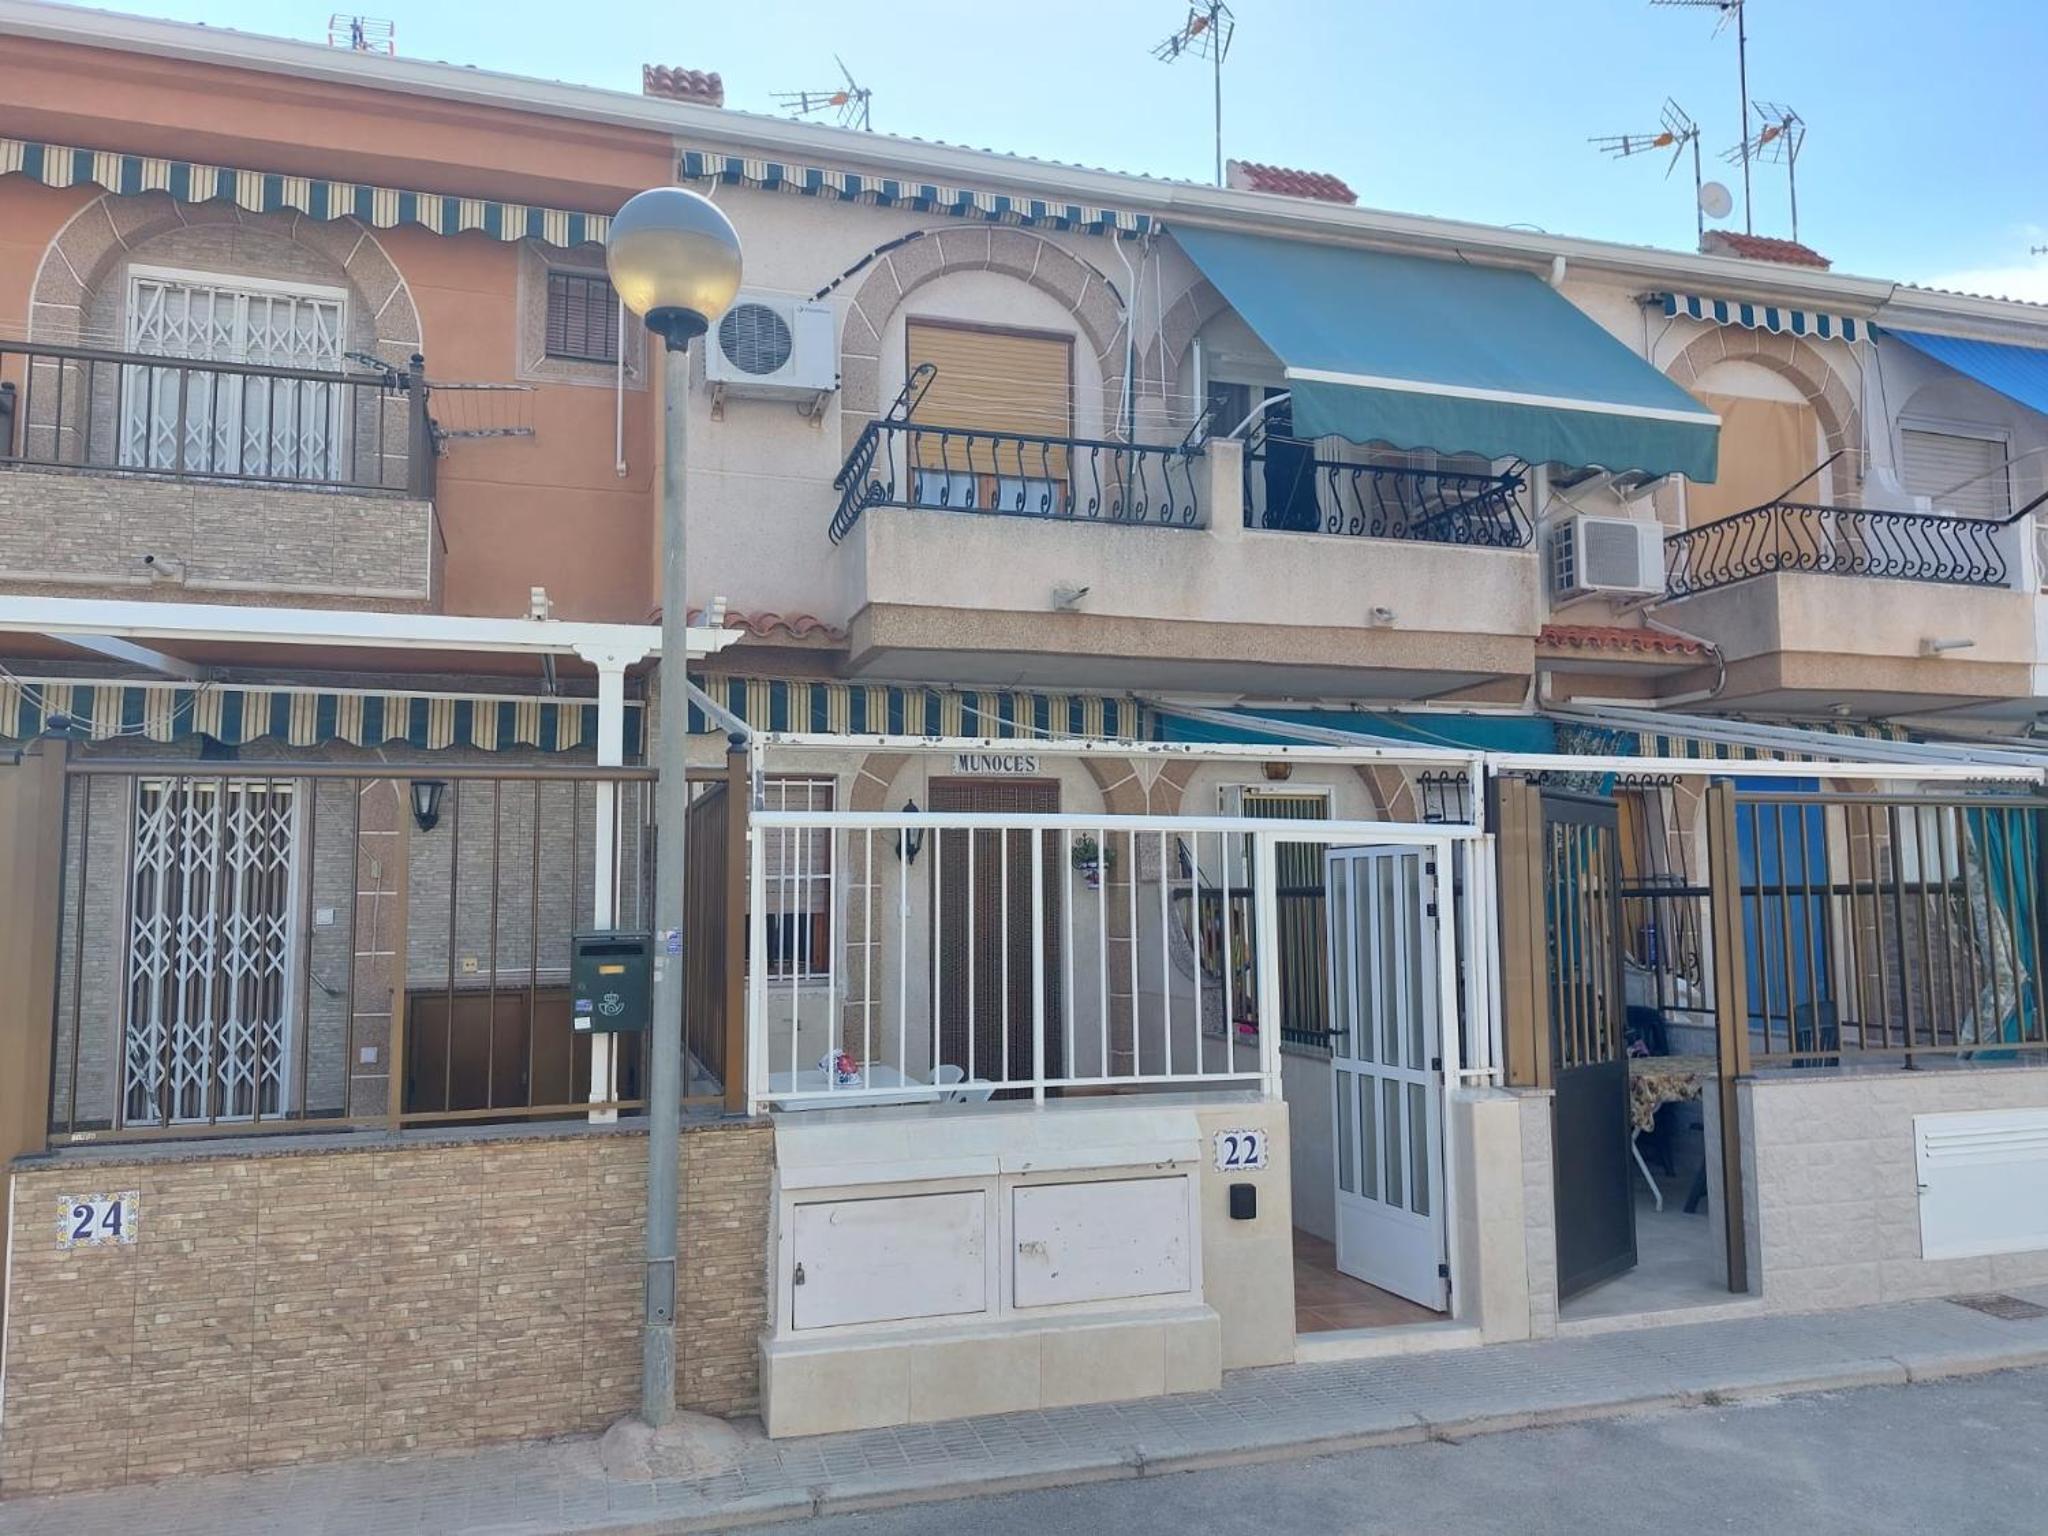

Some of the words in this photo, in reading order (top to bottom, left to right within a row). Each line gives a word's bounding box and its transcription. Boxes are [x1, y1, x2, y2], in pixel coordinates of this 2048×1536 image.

[959, 754, 1036, 772] MUNOCES
[1224, 1135, 1258, 1165] 22
[72, 1200, 122, 1239] 24
